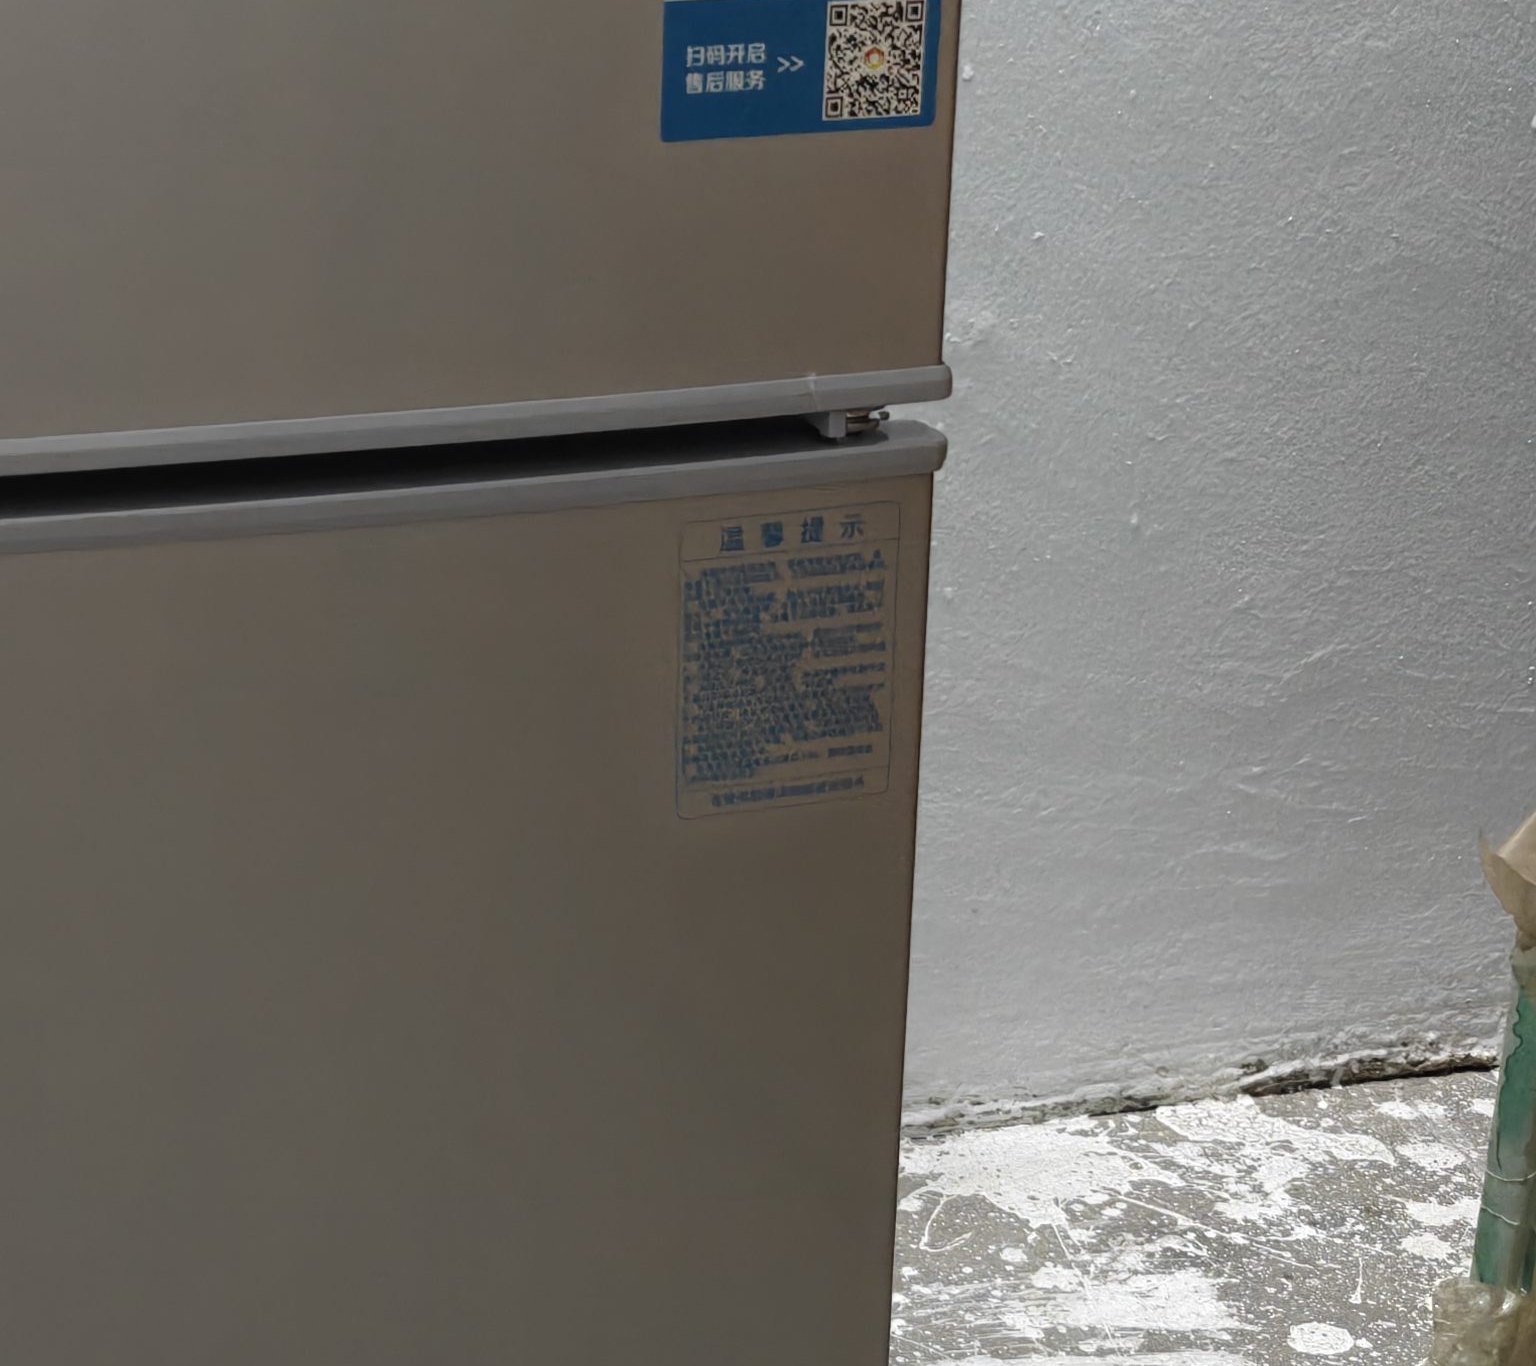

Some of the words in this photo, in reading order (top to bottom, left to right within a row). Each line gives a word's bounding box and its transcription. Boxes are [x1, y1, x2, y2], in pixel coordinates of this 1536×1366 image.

[686, 42, 767, 68] 扫码开启
[685, 69, 767, 94] 售后服务
